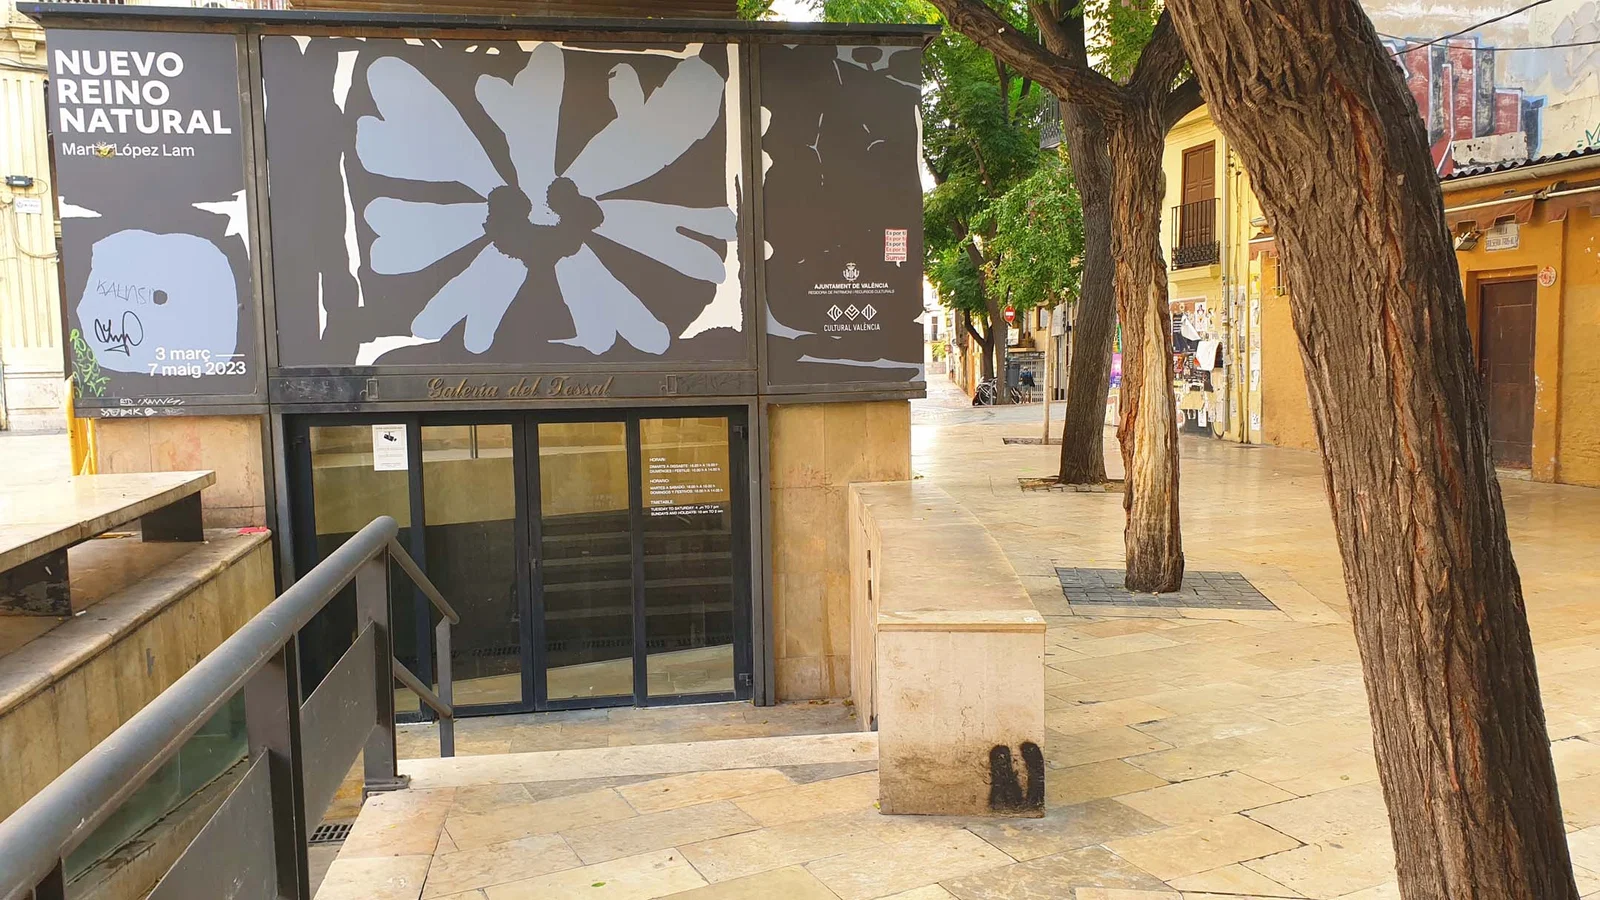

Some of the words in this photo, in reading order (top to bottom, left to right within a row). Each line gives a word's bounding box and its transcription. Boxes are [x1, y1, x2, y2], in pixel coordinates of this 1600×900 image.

[54, 50, 184, 77] NUEVO
[57, 78, 170, 106] REINO
[58, 107, 231, 135] NATURAL
[62, 142, 114, 157] Mart
[114, 142, 159, 159] López
[163, 144, 195, 157] Lam
[823, 323, 852, 332] CULTURAL
[155, 348, 166, 361] 3
[170, 349, 211, 363] març
[147, 363, 158, 376] 7
[161, 363, 201, 379] maig
[205, 361, 246, 375] 2023
[507, 376, 542, 397] del
[549, 375, 615, 397] Tossal
